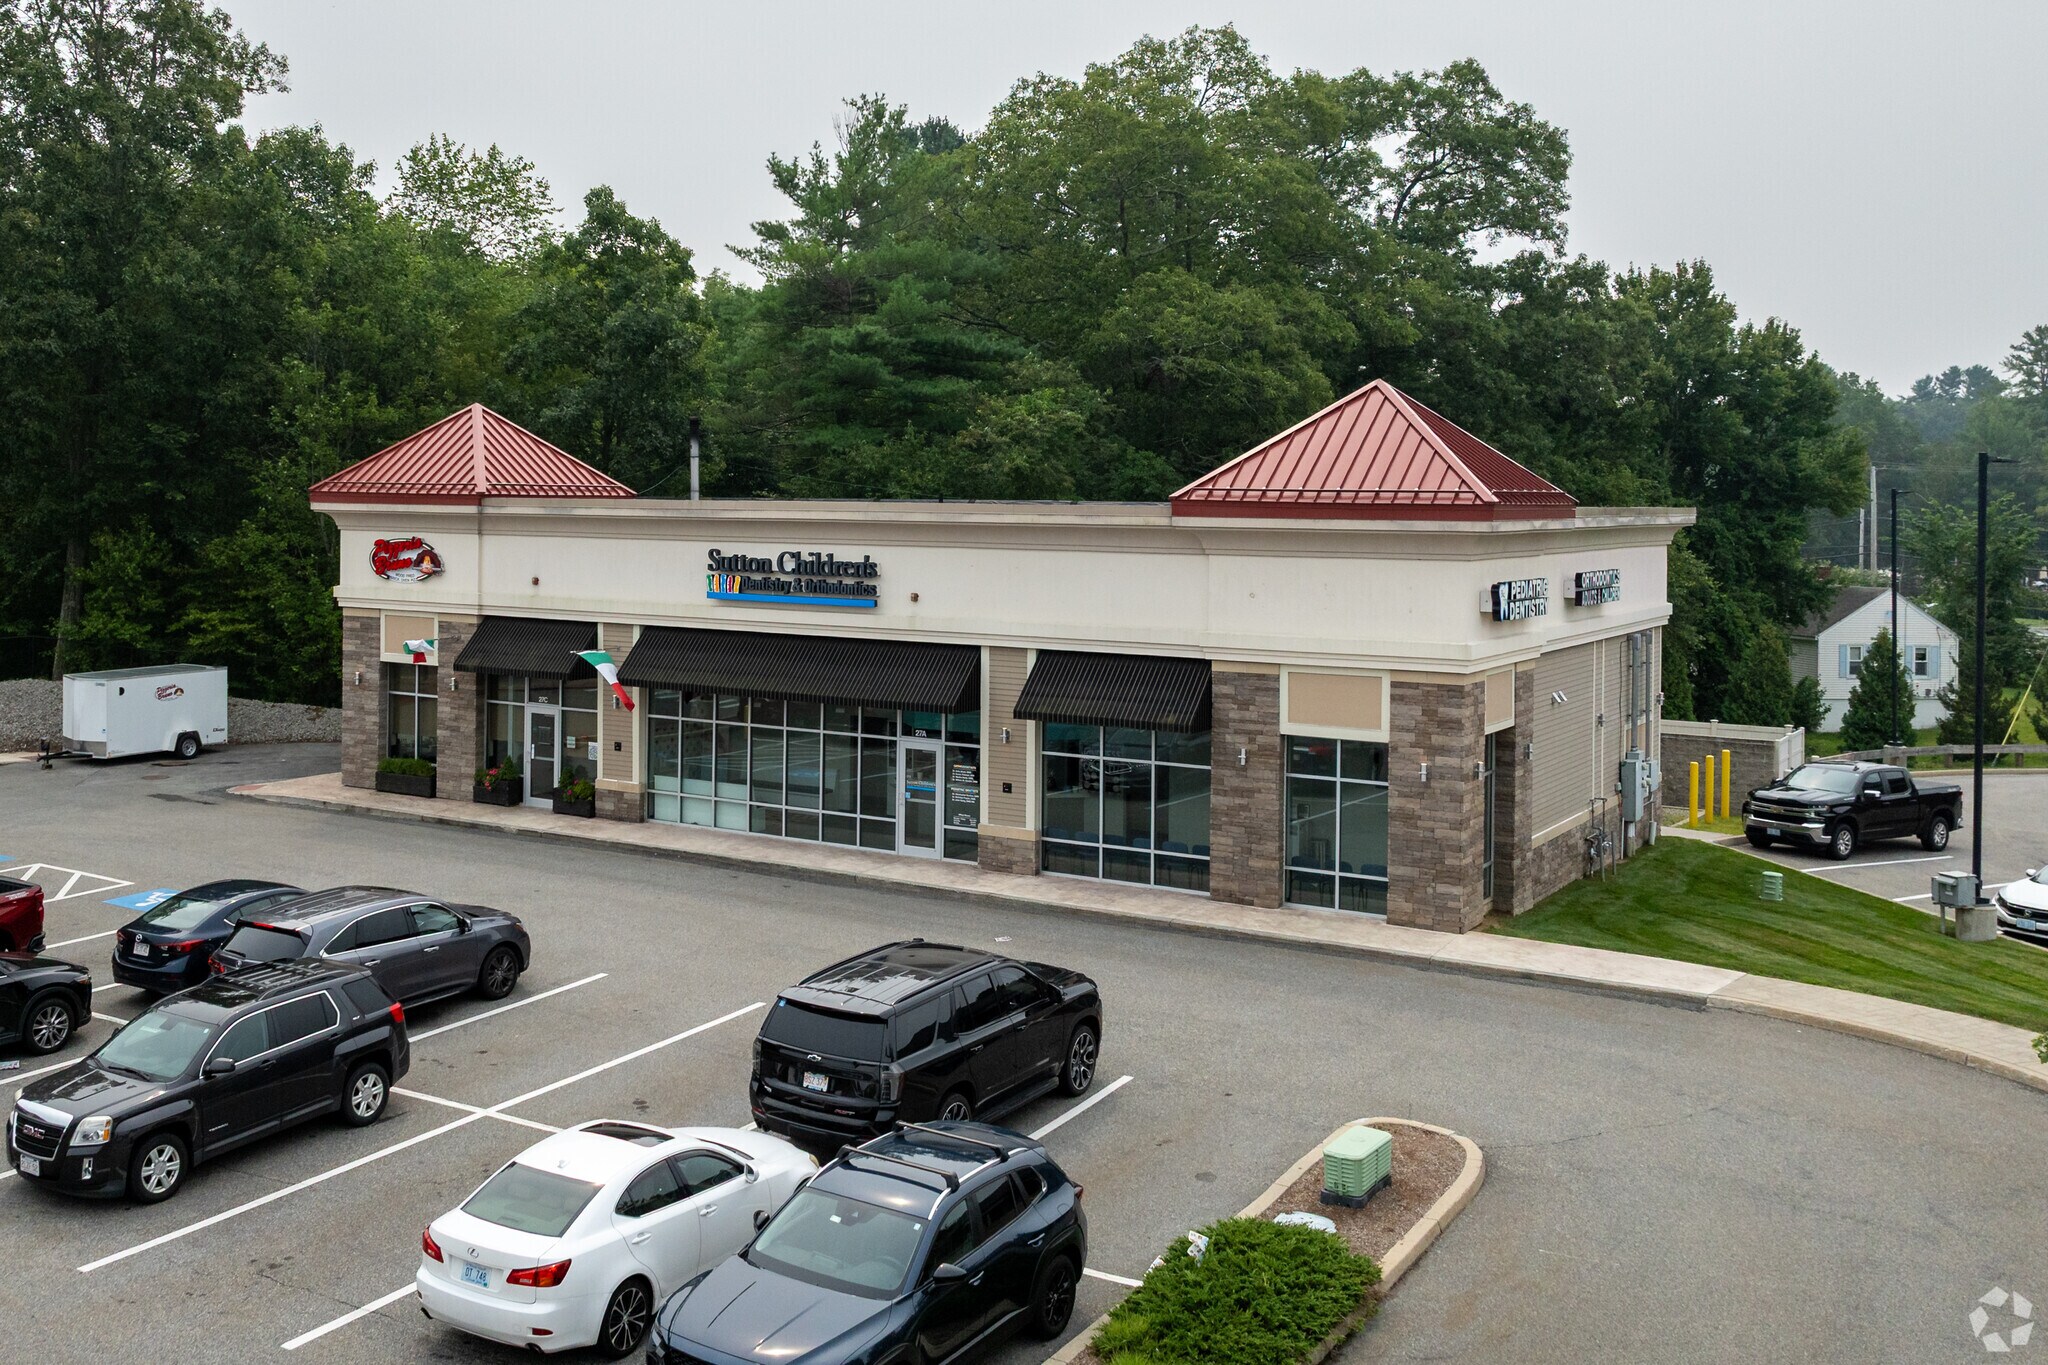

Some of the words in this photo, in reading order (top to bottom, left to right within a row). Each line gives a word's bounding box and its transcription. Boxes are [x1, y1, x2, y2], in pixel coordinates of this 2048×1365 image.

[707, 549, 773, 574] Sutton
[776, 551, 877, 578] Children's
[741, 576, 792, 595] Dentistry
[792, 578, 801, 593] &
[803, 580, 877, 597] Orthodontics
[1511, 578, 1549, 600] PEDIATRIC
[1509, 598, 1549, 620] DENTISTRY
[915, 730, 927, 738] 27A
